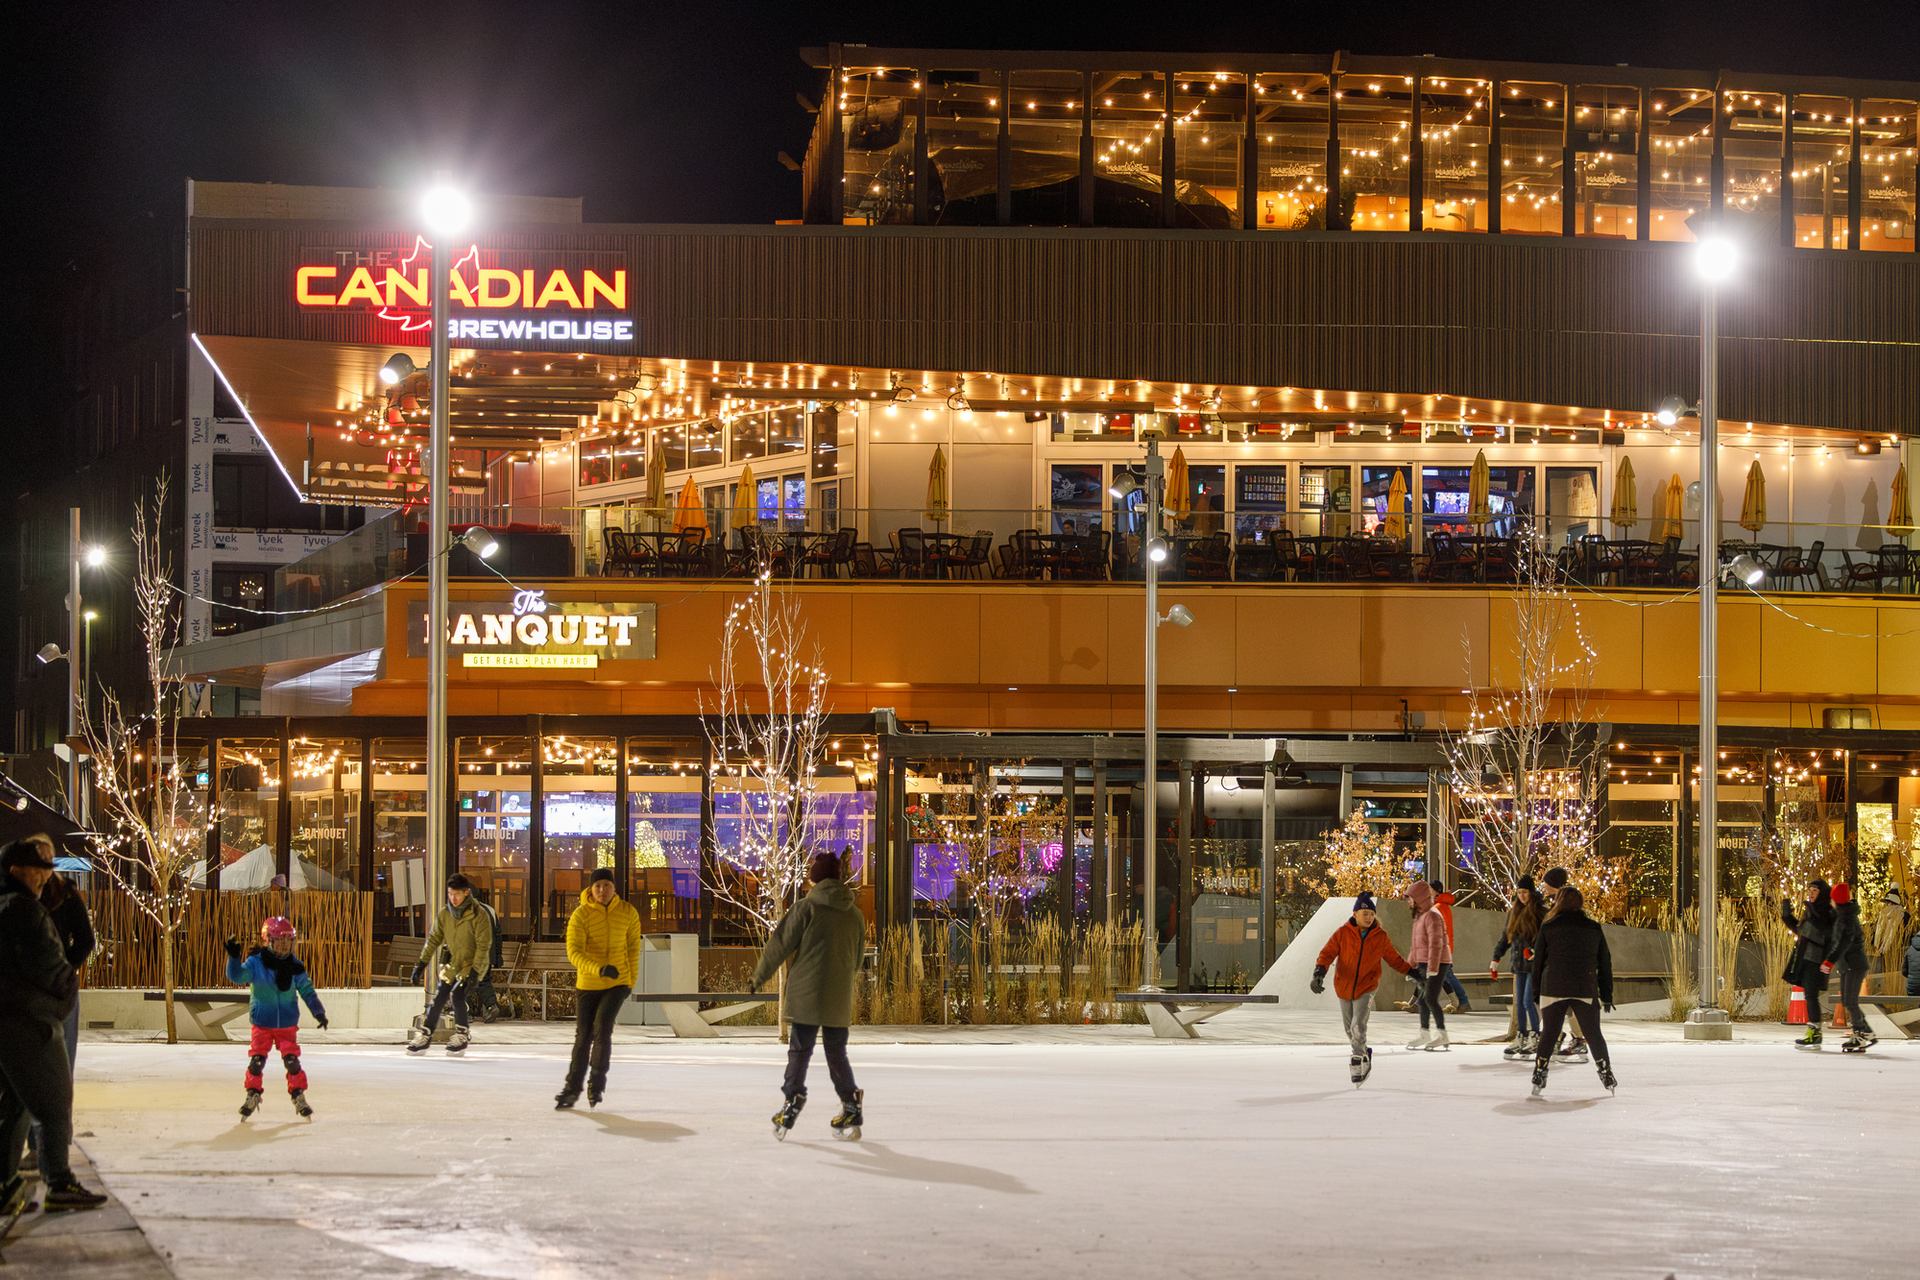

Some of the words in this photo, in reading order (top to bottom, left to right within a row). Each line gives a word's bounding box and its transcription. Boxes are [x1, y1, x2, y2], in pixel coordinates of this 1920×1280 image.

[335, 251, 393, 268] THE
[295, 265, 627, 310] CANADIAN
[191, 463, 203, 494] Tyvek
[212, 533, 238, 546] yvek
[191, 569, 203, 600] Tyvek
[512, 589, 547, 617] The
[191, 617, 203, 645] yvek
[472, 656, 491, 665] GET
[496, 656, 520, 666] REAL
[534, 657, 558, 666] PLAY
[304, 827, 347, 839] BANQUET
[1717, 837, 1749, 849] NQUET
